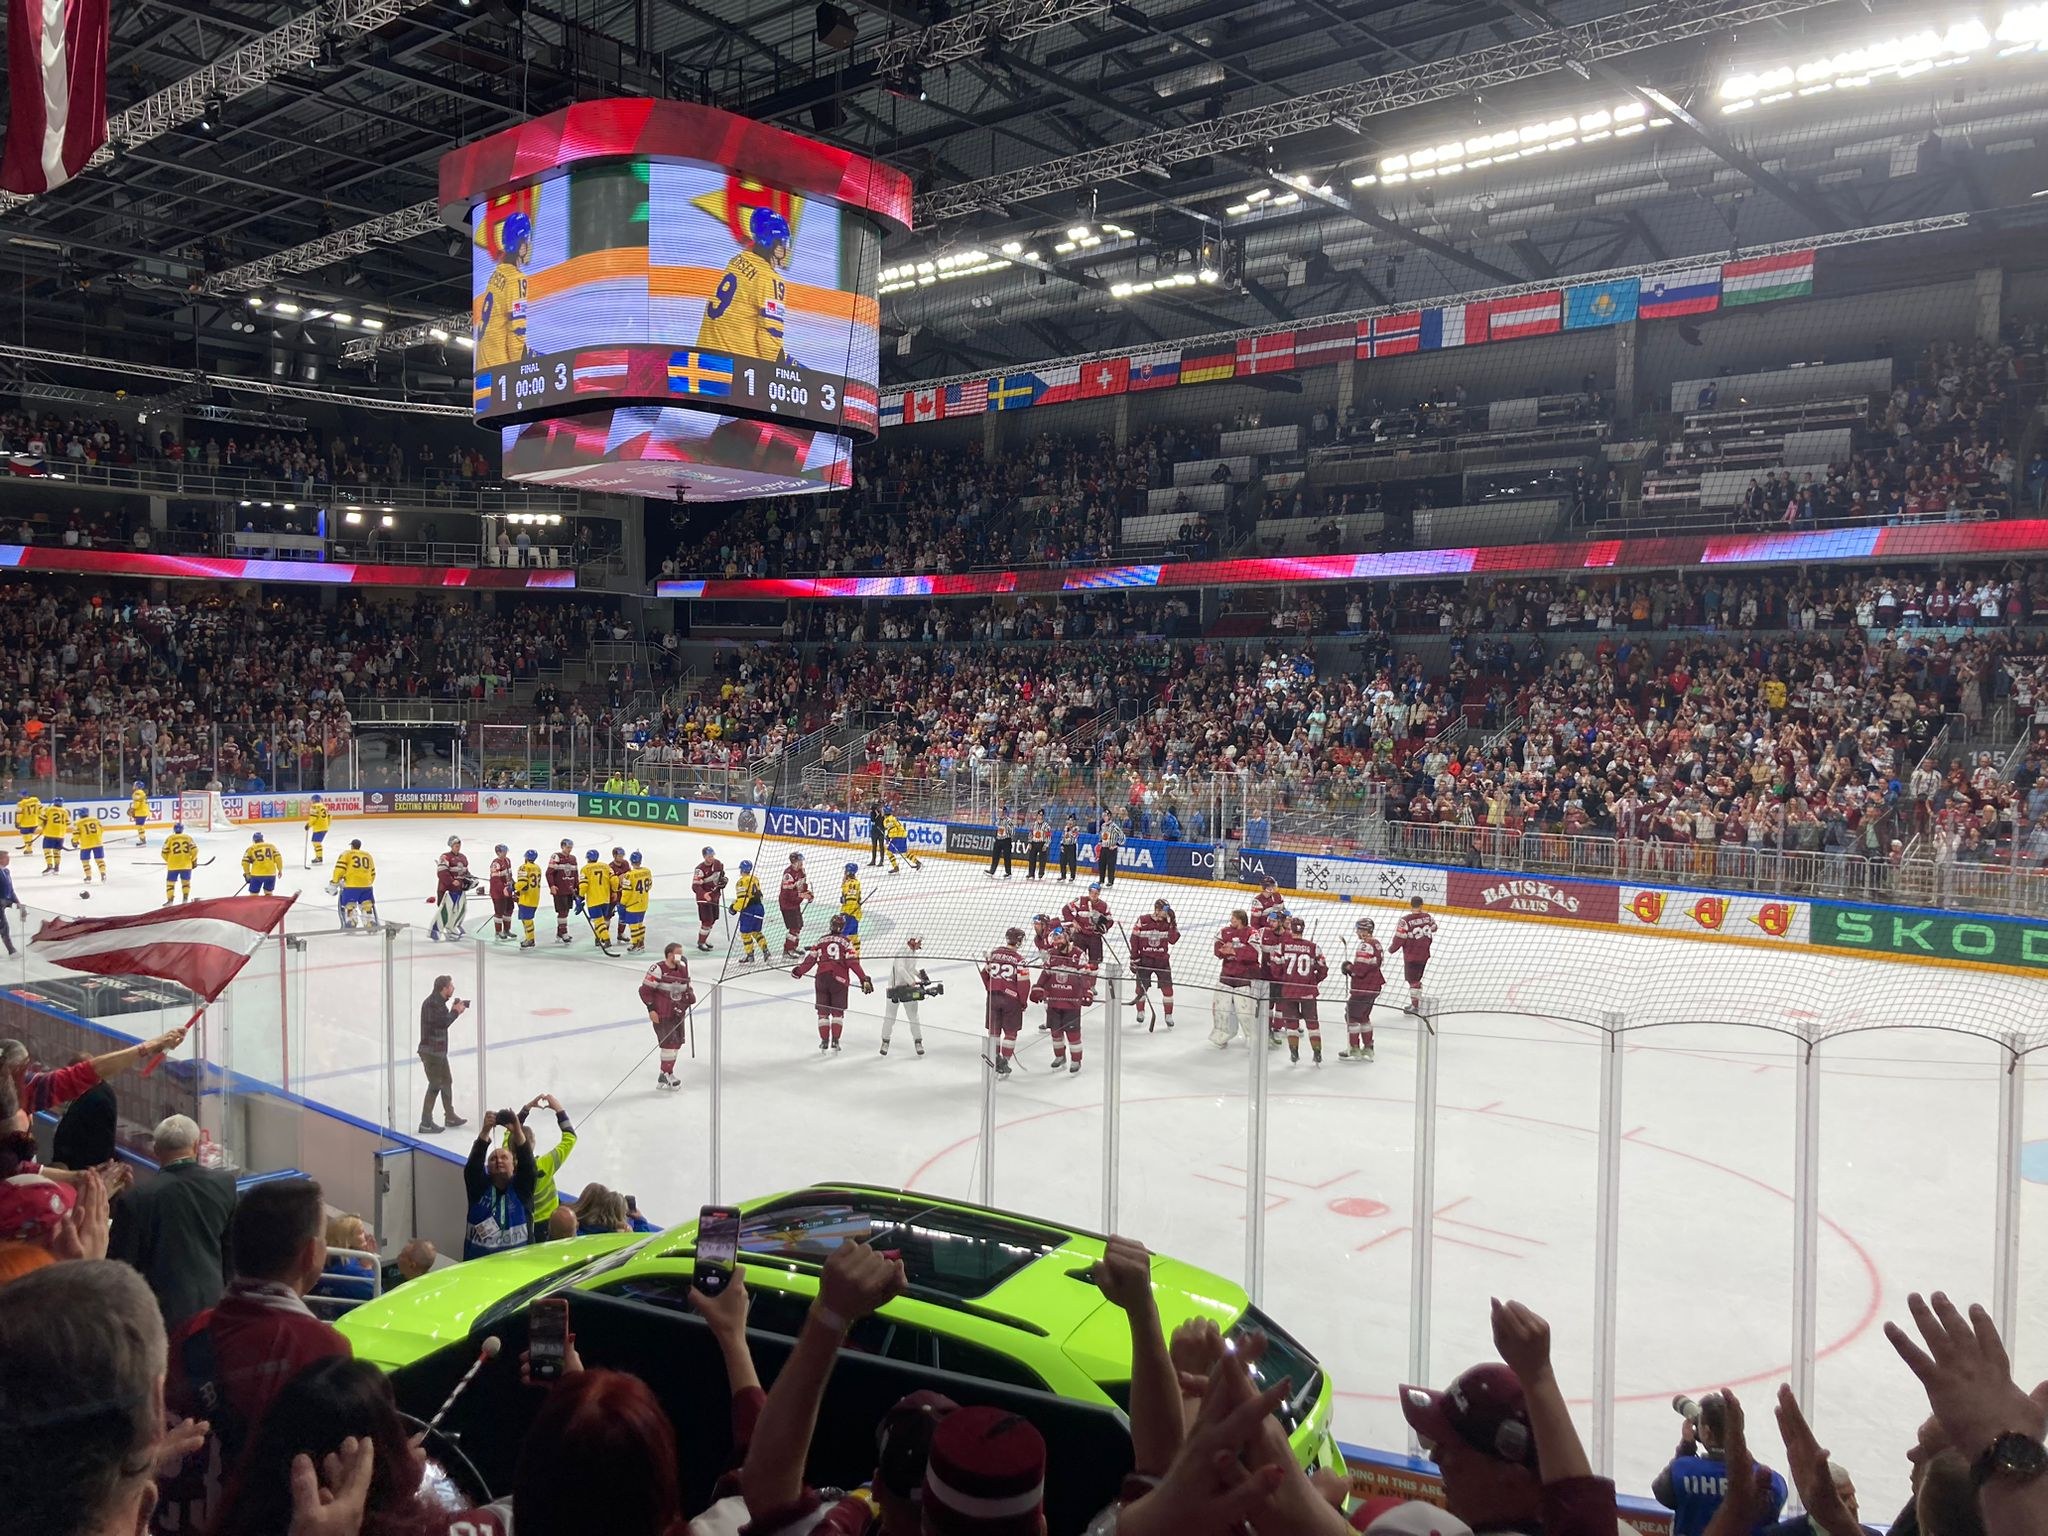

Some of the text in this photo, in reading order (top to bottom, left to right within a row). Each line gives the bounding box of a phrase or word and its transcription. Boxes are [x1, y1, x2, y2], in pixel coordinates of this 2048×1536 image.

[520, 362, 540, 375] FINAL
[775, 367, 801, 382] FINAL
[554, 363, 568, 390] 3
[744, 368, 755, 396] 1
[498, 375, 507, 401] 1
[515, 376, 545, 398] 00:00
[768, 381, 808, 405] 00:00
[820, 384, 836, 410] 3
[394, 793, 419, 802] SEASON
[420, 793, 443, 802] STARTS
[444, 793, 452, 802] 31
[453, 793, 477, 803] AUGUST
[504, 797, 576, 810] #Together4Integrity
[394, 802, 463, 811] EXCITING NEW FORMAT
[705, 809, 734, 821] TISSOT
[769, 812, 846, 840] VENDEN
[172, 841, 190, 854] 23
[254, 848, 272, 862] 54
[352, 855, 369, 869] 30
[594, 870, 603, 885] 7
[1480, 879, 1581, 913] BAUSKAS
[1510, 898, 1550, 913] ALUS
[827, 943, 840, 960] 9
[1284, 953, 1311, 976] 70
